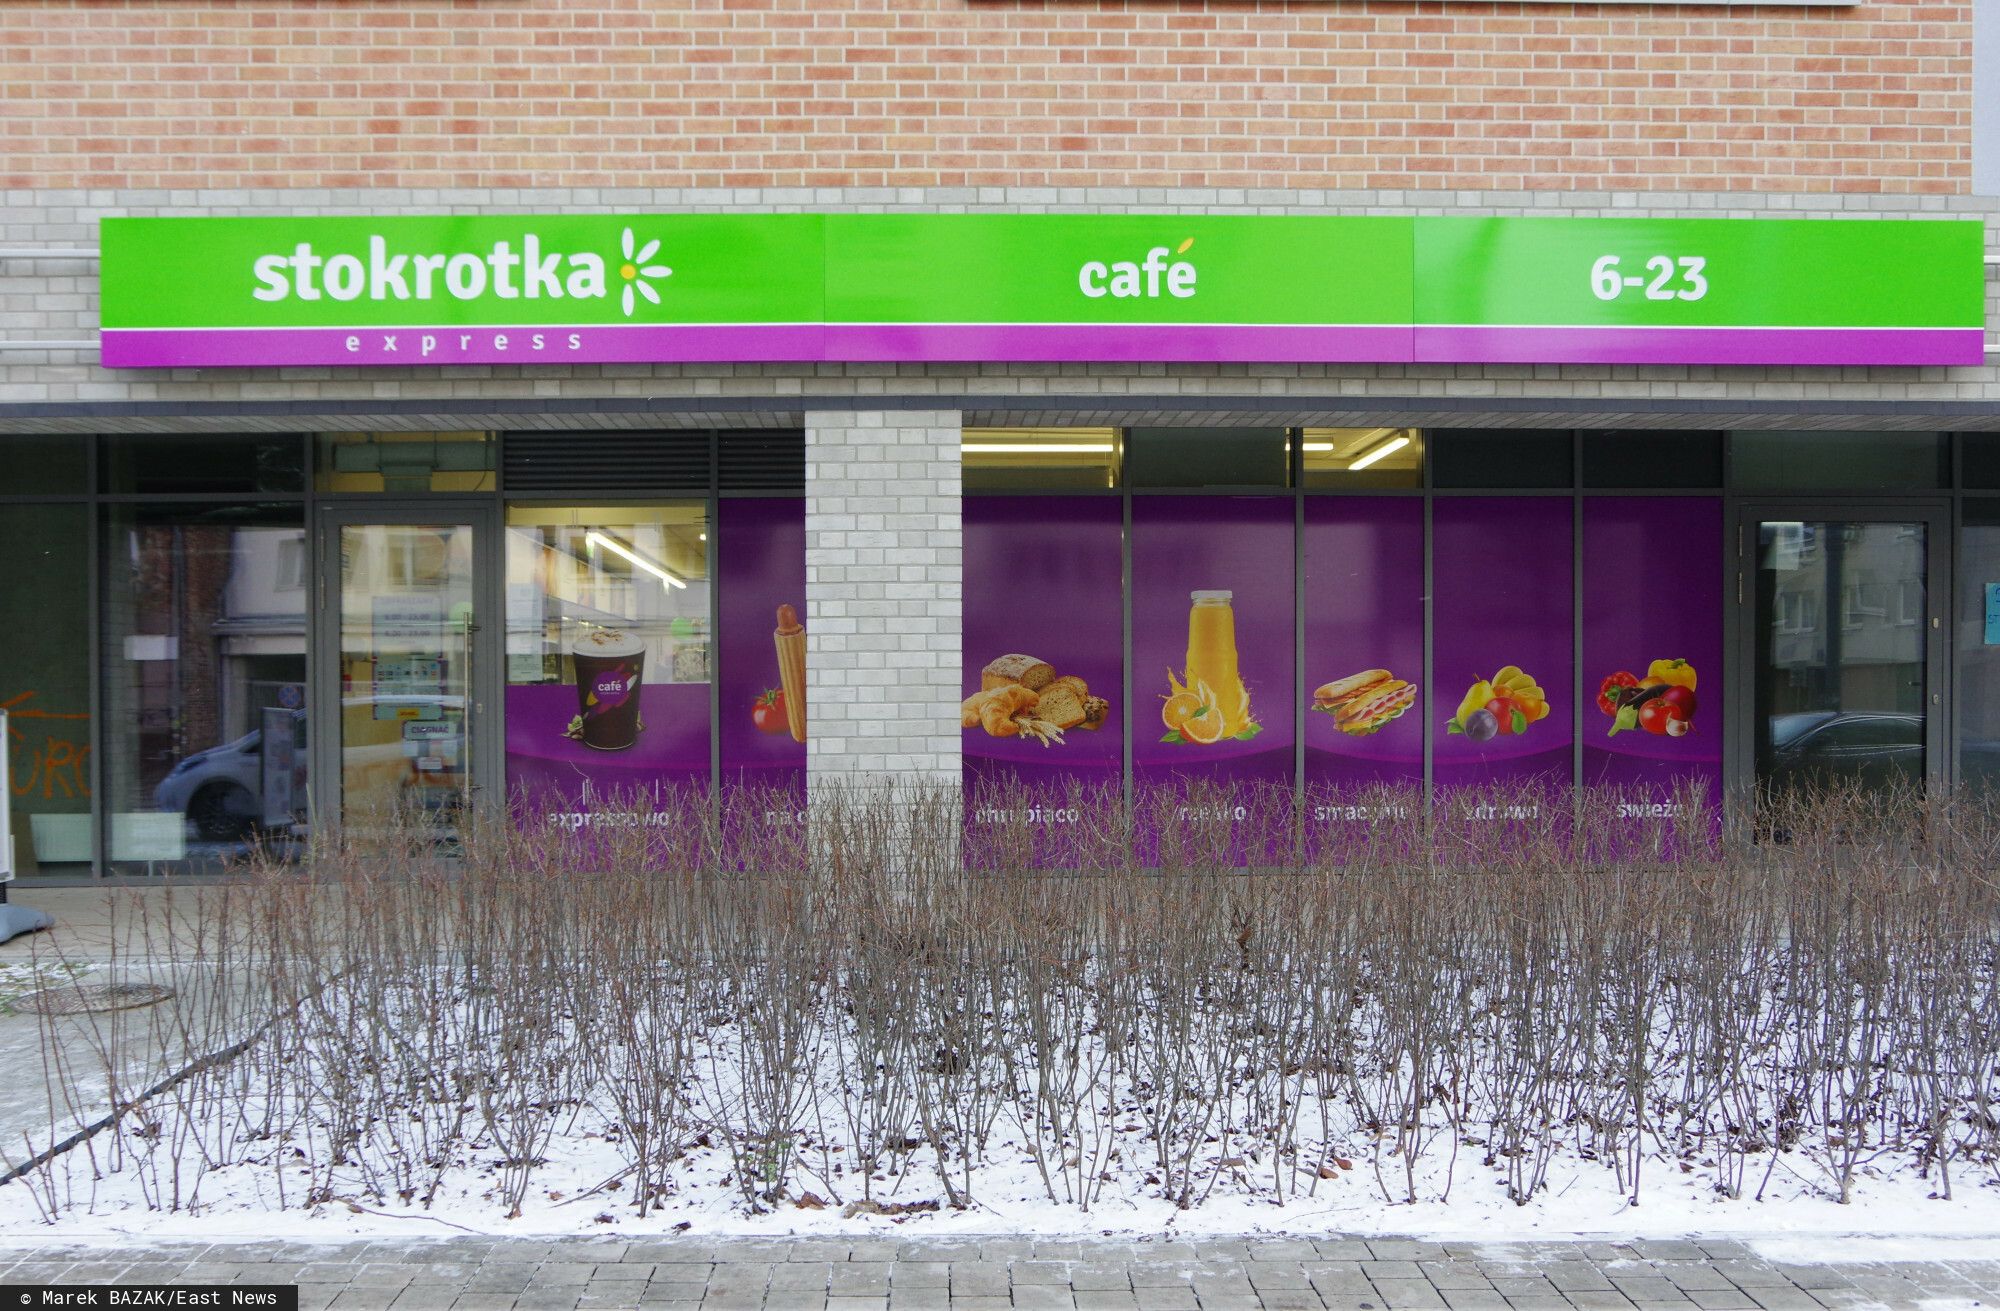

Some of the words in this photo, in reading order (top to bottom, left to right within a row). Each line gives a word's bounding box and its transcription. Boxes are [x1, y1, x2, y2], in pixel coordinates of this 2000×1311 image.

[252, 233, 608, 302] stokrotka
[1078, 237, 1197, 299] café
[1590, 254, 1708, 301] 6-23
[345, 331, 582, 357] express
[597, 680, 622, 692] café
